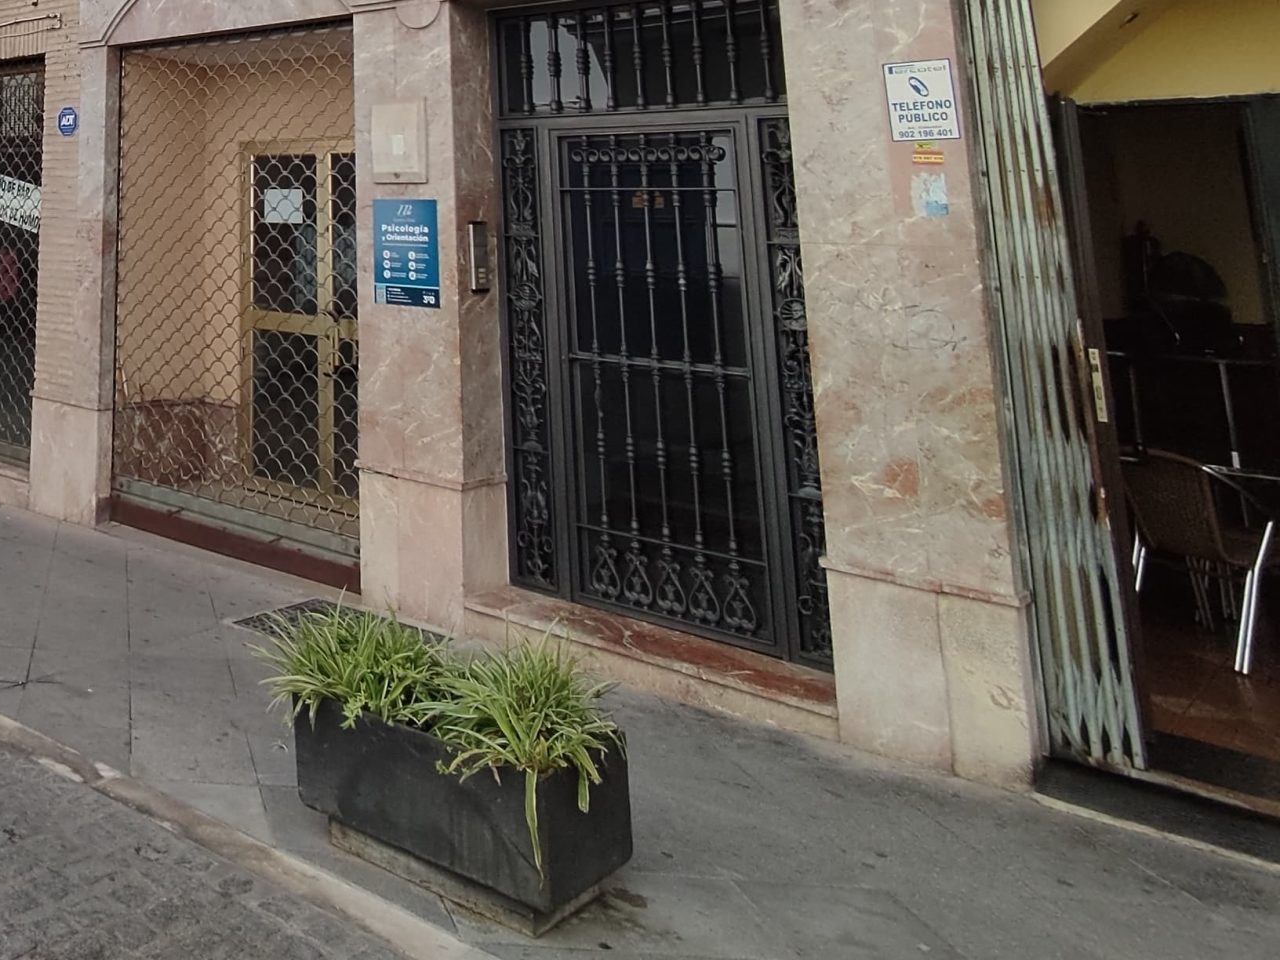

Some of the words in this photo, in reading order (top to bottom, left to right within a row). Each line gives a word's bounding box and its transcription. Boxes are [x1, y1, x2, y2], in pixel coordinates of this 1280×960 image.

[60, 114, 75, 126] ADT
[898, 130, 915, 139] 902
[936, 128, 953, 137] 401
[386, 234, 429, 242] Orientación
